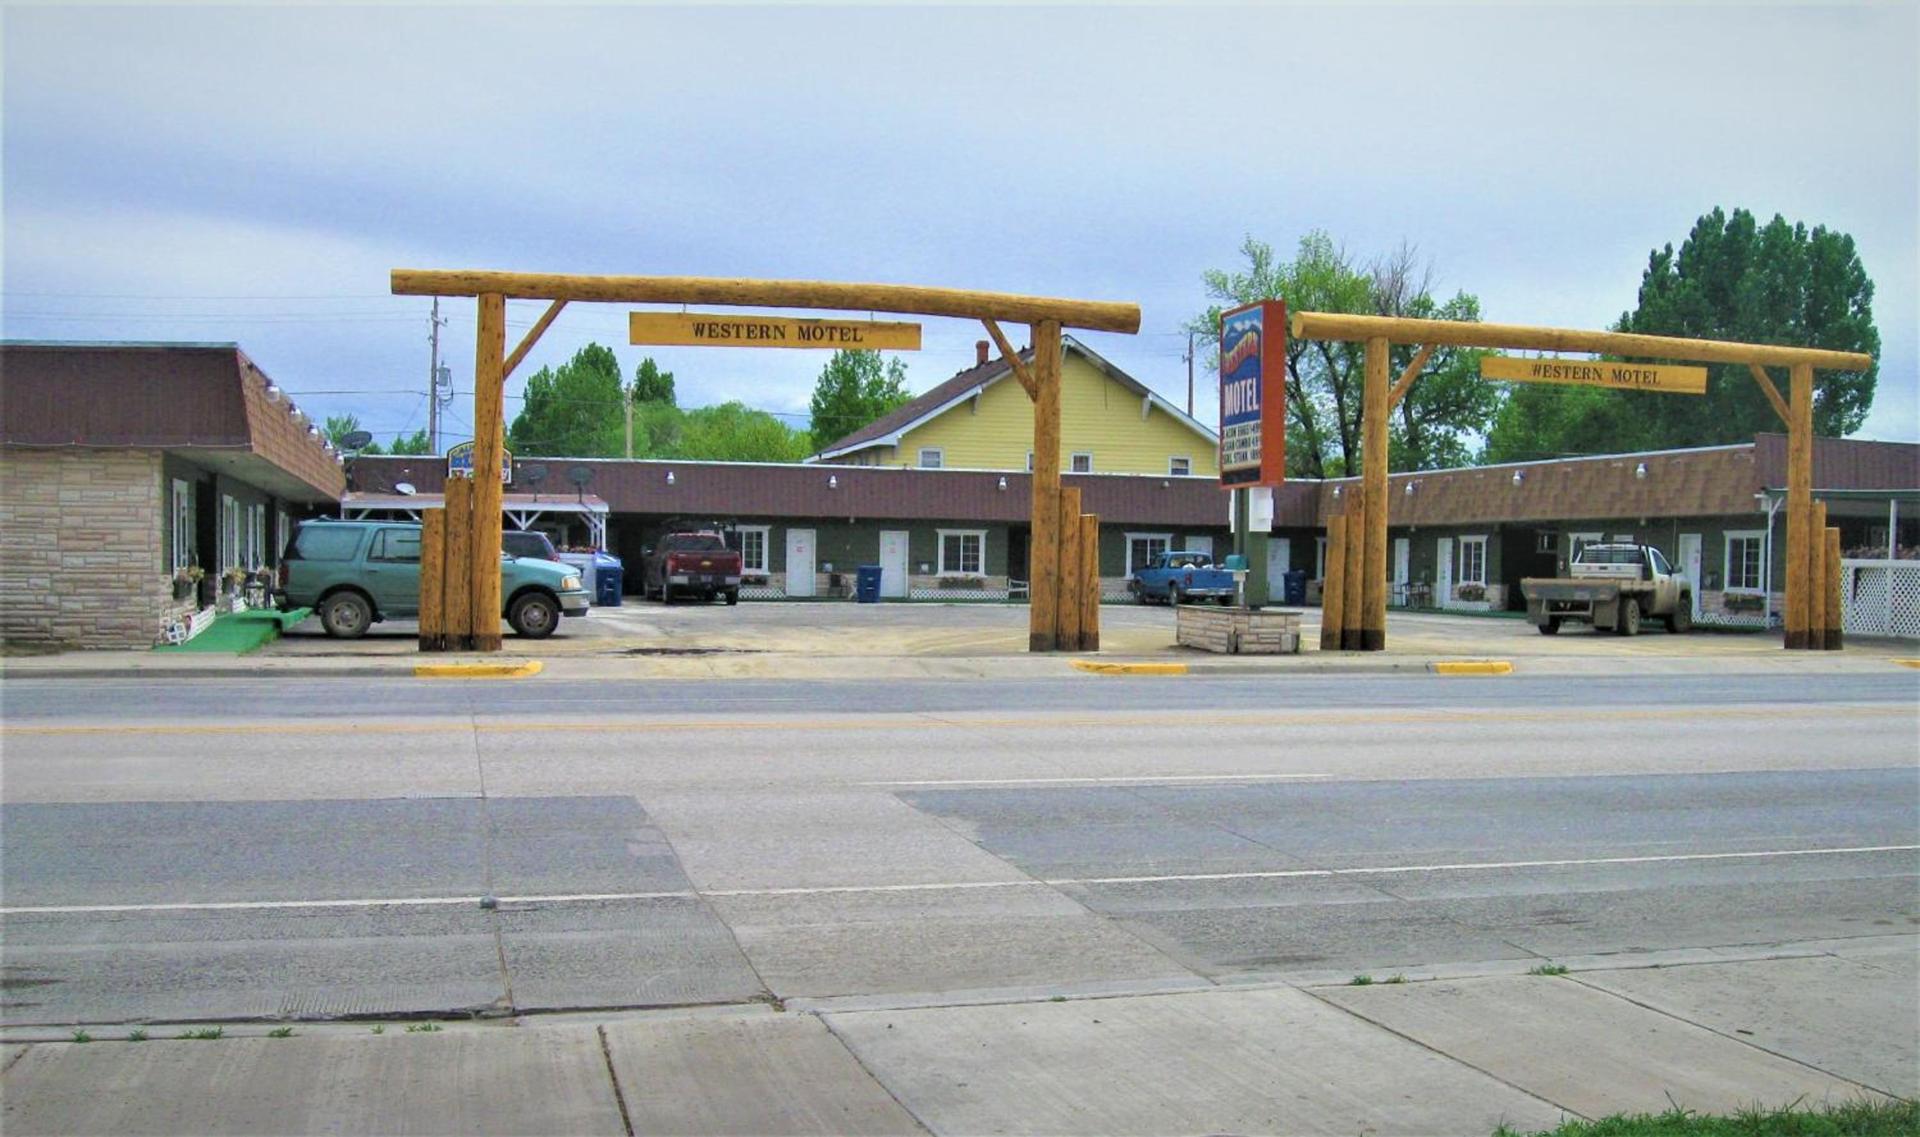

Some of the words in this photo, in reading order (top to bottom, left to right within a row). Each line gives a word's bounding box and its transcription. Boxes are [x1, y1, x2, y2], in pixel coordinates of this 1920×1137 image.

[692, 322, 786, 340] WESTERN
[798, 325, 863, 342] MOTEL
[1531, 363, 1602, 380] WESTERN
[1611, 368, 1660, 384] MOTEL
[1225, 378, 1259, 416] MOTEL
